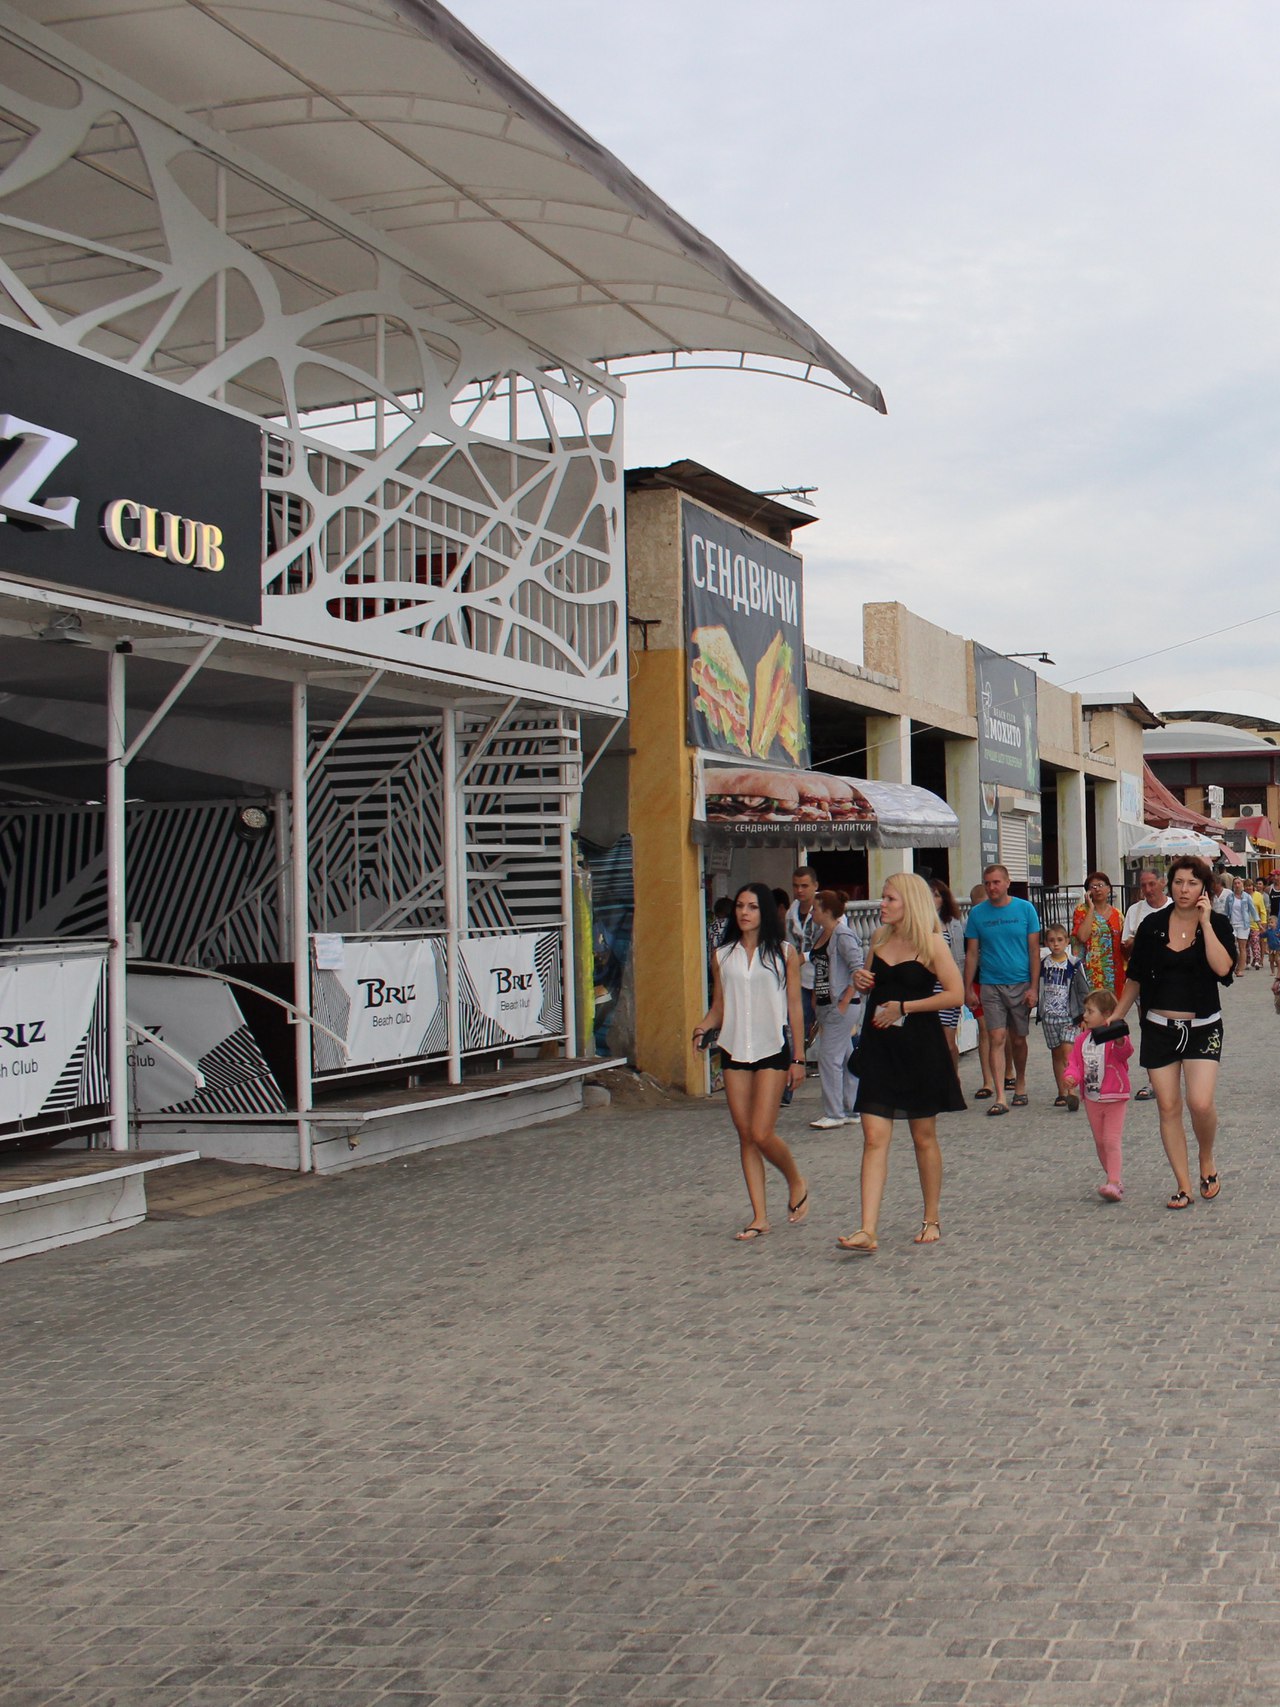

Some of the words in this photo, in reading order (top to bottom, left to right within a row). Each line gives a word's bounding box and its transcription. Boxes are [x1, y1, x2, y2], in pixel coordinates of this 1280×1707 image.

[0, 414, 80, 533] Z
[104, 499, 225, 572] CLUB
[691, 534, 798, 627] СЕНДВИЧИ
[989, 717, 1022, 748] МОХИТО
[735, 824, 780, 833] СЕНДВИЧИ
[794, 824, 817, 832] ПИВО
[832, 823, 871, 832] НАПИТКИ
[357, 978, 416, 1008] BRIZ
[490, 968, 533, 994] BRIZ
[372, 1014, 393, 1027] Beach
[395, 1013, 411, 1025] Club
[0, 1021, 46, 1048] RIZ
[12, 1059, 39, 1076] Club
